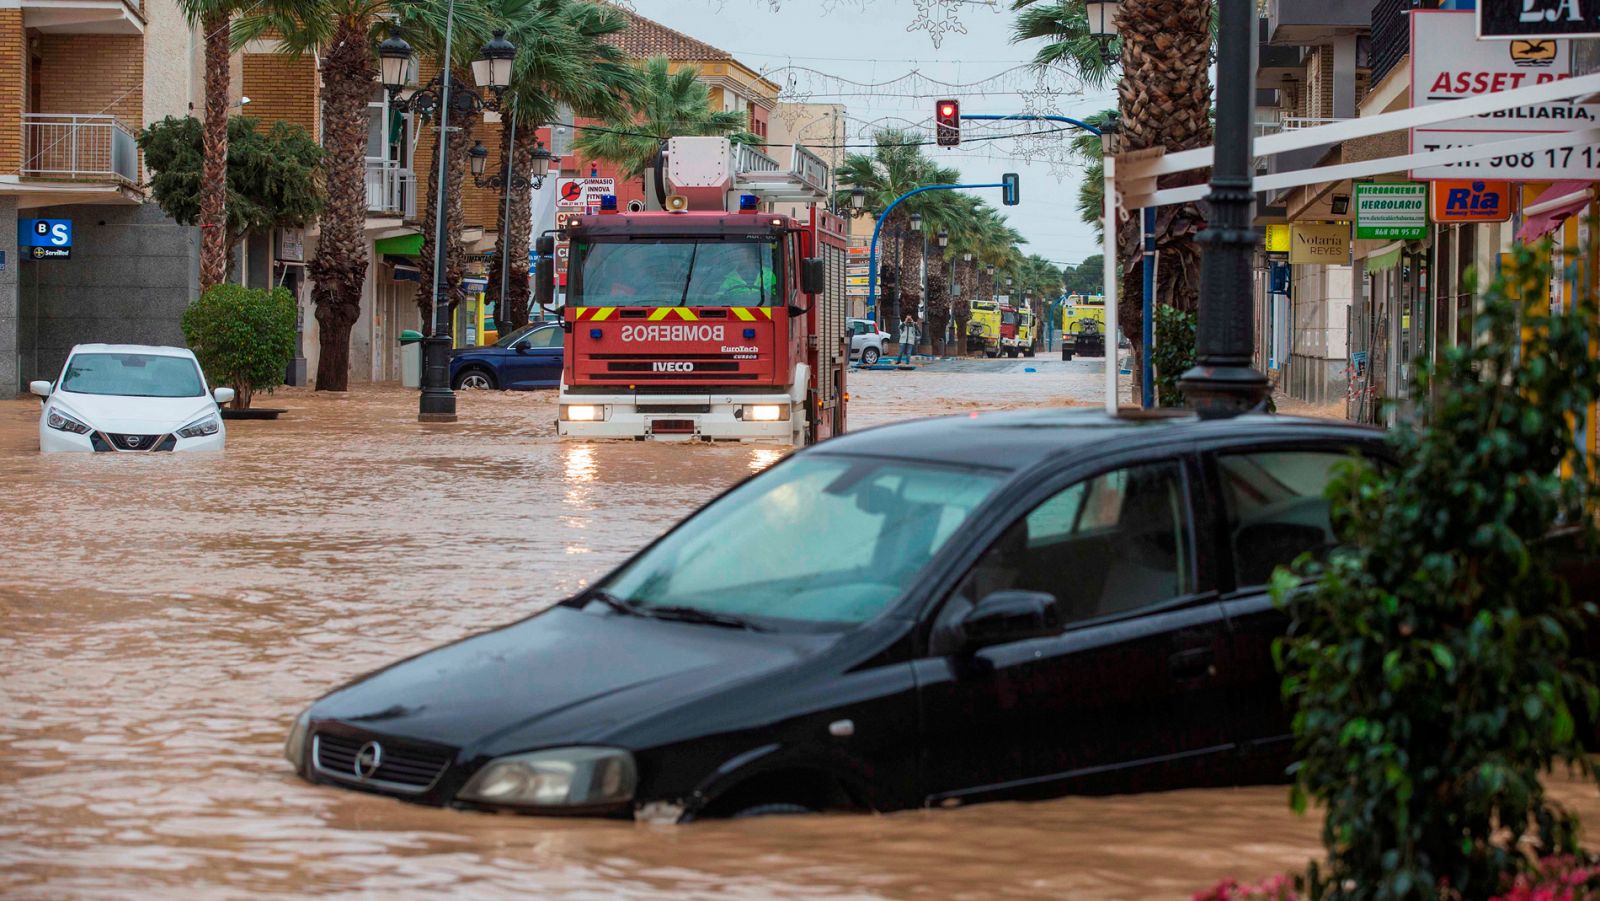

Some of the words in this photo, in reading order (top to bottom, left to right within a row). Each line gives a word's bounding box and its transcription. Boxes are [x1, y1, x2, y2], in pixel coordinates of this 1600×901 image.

[1430, 72, 1526, 94] ASSET
[1545, 147, 1574, 169] 17
[1446, 181, 1500, 209] Ria
[1361, 200, 1423, 210] HERBOLARIO
[38, 224, 47, 233] B
[51, 224, 68, 246] S
[1298, 232, 1342, 246] Notaría
[1310, 246, 1343, 256] REYES
[721, 345, 759, 353] EuroTech
[652, 362, 694, 372] IVECO
